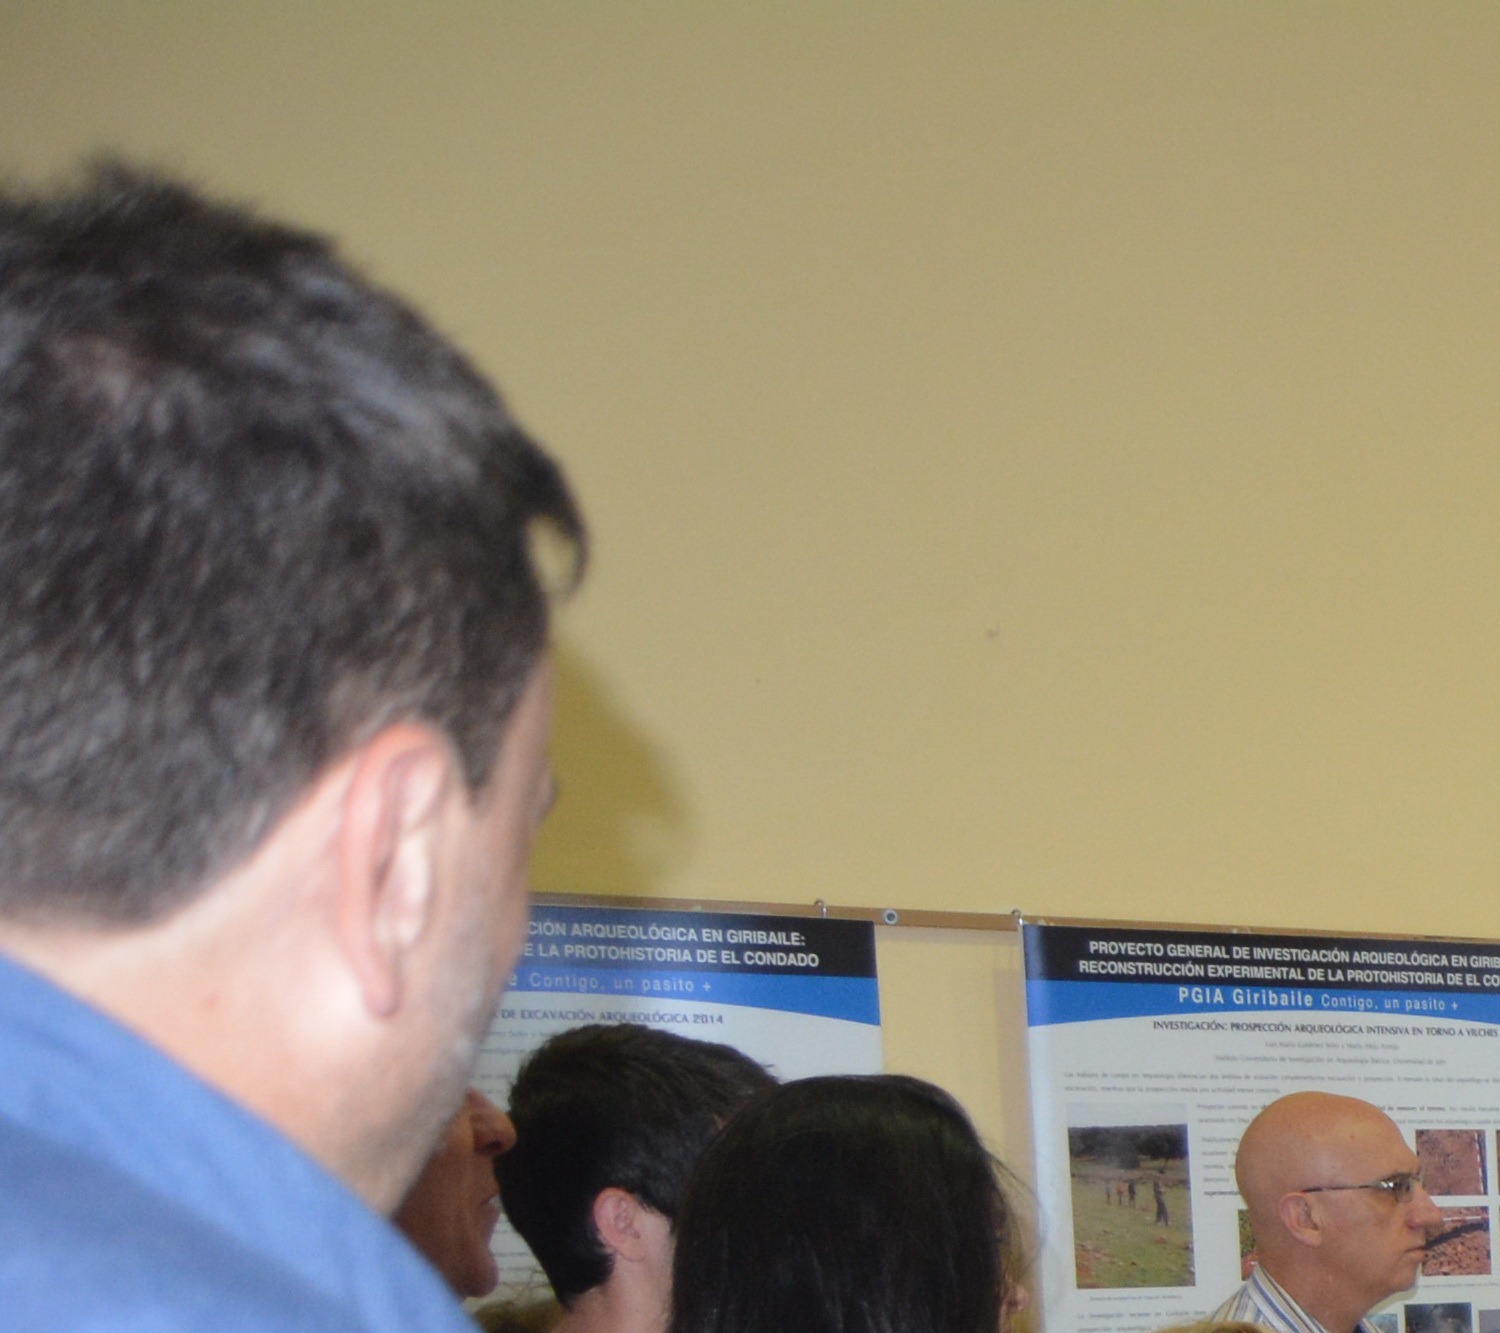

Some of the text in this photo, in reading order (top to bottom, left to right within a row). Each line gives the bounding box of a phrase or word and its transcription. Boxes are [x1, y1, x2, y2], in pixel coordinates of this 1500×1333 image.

[570, 923, 698, 942] ARQUEOLÓGICA
[701, 929, 723, 943] EN
[726, 930, 805, 946] GIRIBAILE:
[538, 943, 560, 957] LA
[563, 944, 692, 962] PROTOHISTORIA
[696, 949, 717, 963] DE
[721, 950, 741, 964] EL
[743, 951, 819, 967] CONDADO
[1089, 942, 1164, 957] PROYECTO
[1166, 944, 1230, 960] GENERAL
[1232, 946, 1250, 960] DE
[1253, 947, 1350, 964] INVESTIGACIÓN
[1352, 949, 1449, 967] ARQUEOLÓGICA
[1451, 954, 1468, 967] EN
[529, 973, 611, 992] Contigo,
[614, 978, 633, 990] un
[639, 976, 694, 993] pasito
[1079, 961, 1204, 977] RECONSTRUCCIÓN
[1207, 965, 1305, 980] EXPERIMENTAL
[1307, 968, 1325, 981] DE
[1327, 968, 1344, 982] LA
[1347, 969, 1445, 985] PROTOHISTORIA
[1446, 972, 1463, 985] DE
[1465, 972, 1481, 986] EL
[1179, 987, 1225, 1004] PGIA
[1232, 988, 1314, 1006] Giribaile
[1321, 993, 1378, 1011] Contigo,
[1384, 998, 1399, 1009] un
[1405, 997, 1446, 1012] pasito
[1153, 1020, 1498, 1037] INVESTIGACIÓN: PROSPECCIÓN ARQUEOLÓGICA INTENSIVA EN TORNO A VILCHES
